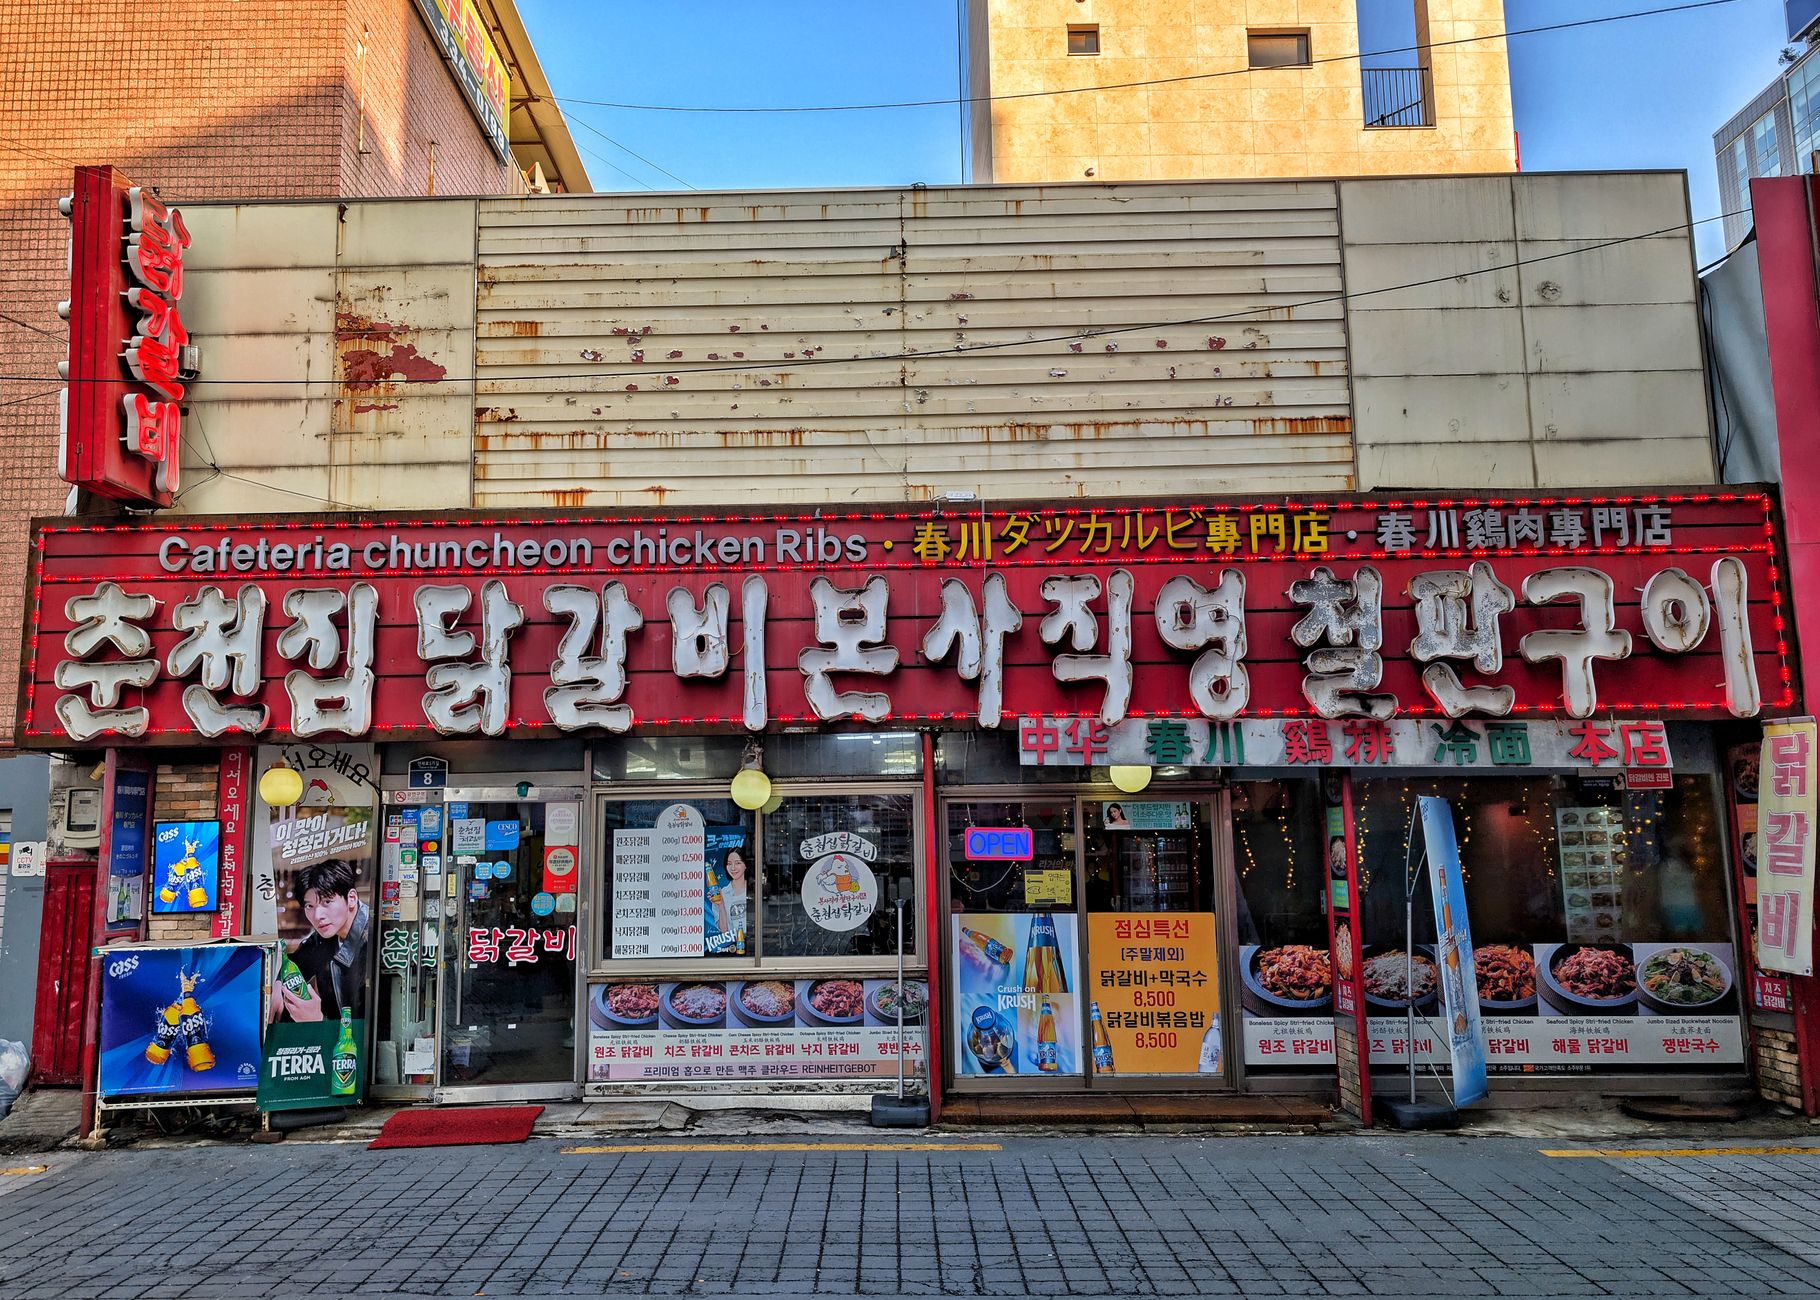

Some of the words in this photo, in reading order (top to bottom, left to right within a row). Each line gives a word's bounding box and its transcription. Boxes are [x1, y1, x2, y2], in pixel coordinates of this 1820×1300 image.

[159, 535, 351, 573] Cafeteria
[363, 532, 593, 569] chuncheon
[606, 529, 766, 566] chicken
[776, 529, 868, 563] Ribs
[53, 580, 379, 741] 춘천집
[413, 574, 769, 737] 닭갈비
[799, 567, 1250, 729] 본사직영
[1289, 556, 1761, 722] 철판구이
[1021, 720, 1108, 766] 中华
[1146, 719, 1245, 765] 春川
[1431, 720, 1532, 765] 冷面
[1571, 719, 1668, 767] 本店
[423, 772, 433, 785] 8
[276, 824, 293, 841] 이
[969, 832, 1030, 855] OPEN
[217, 901, 236, 937] 닭갈
[1114, 919, 1190, 939] 점심특선
[468, 925, 577, 963] 닭갈비
[705, 929, 738, 952] KRUSH
[109, 954, 139, 978] Cass
[1100, 969, 1208, 988] 닭갈비+막국수
[997, 985, 1019, 993] Crush
[1764, 982, 1782, 994] 치즈
[997, 994, 1036, 1012] KRUSH
[1133, 990, 1175, 1008] 8,500
[1106, 1011, 1205, 1029] 닭갈비볶음밥
[801, 1043, 823, 1055] 낙지
[827, 1042, 860, 1055] 닭갈비
[877, 1041, 922, 1055] 쟁반국수
[1135, 1032, 1177, 1049] 8,500
[1258, 1039, 1287, 1055] 원조
[1292, 1039, 1333, 1055] 닭갈비
[1391, 1038, 1433, 1054] 닭갈비
[1488, 1038, 1530, 1054] 닭갈비
[1552, 1038, 1582, 1054] 해물
[1587, 1038, 1629, 1054] 닭갈비
[1662, 1038, 1720, 1053] 쟁반국수
[594, 1046, 616, 1058] 원조
[621, 1045, 653, 1058] 닭갈비
[664, 1045, 686, 1058] 치즈
[691, 1044, 723, 1057] 닭갈비
[729, 1044, 760, 1056] 콘치즈
[764, 1043, 795, 1056] 닭갈비
[268, 1053, 326, 1078] TERRA
[332, 1057, 357, 1071] TERRA
[643, 1066, 679, 1077] 프리미엄
[716, 1065, 735, 1076] 만든
[738, 1064, 757, 1075] 맥주
[760, 1064, 799, 1075] 클라우드
[802, 1063, 877, 1074] REINHEITGEBOT
